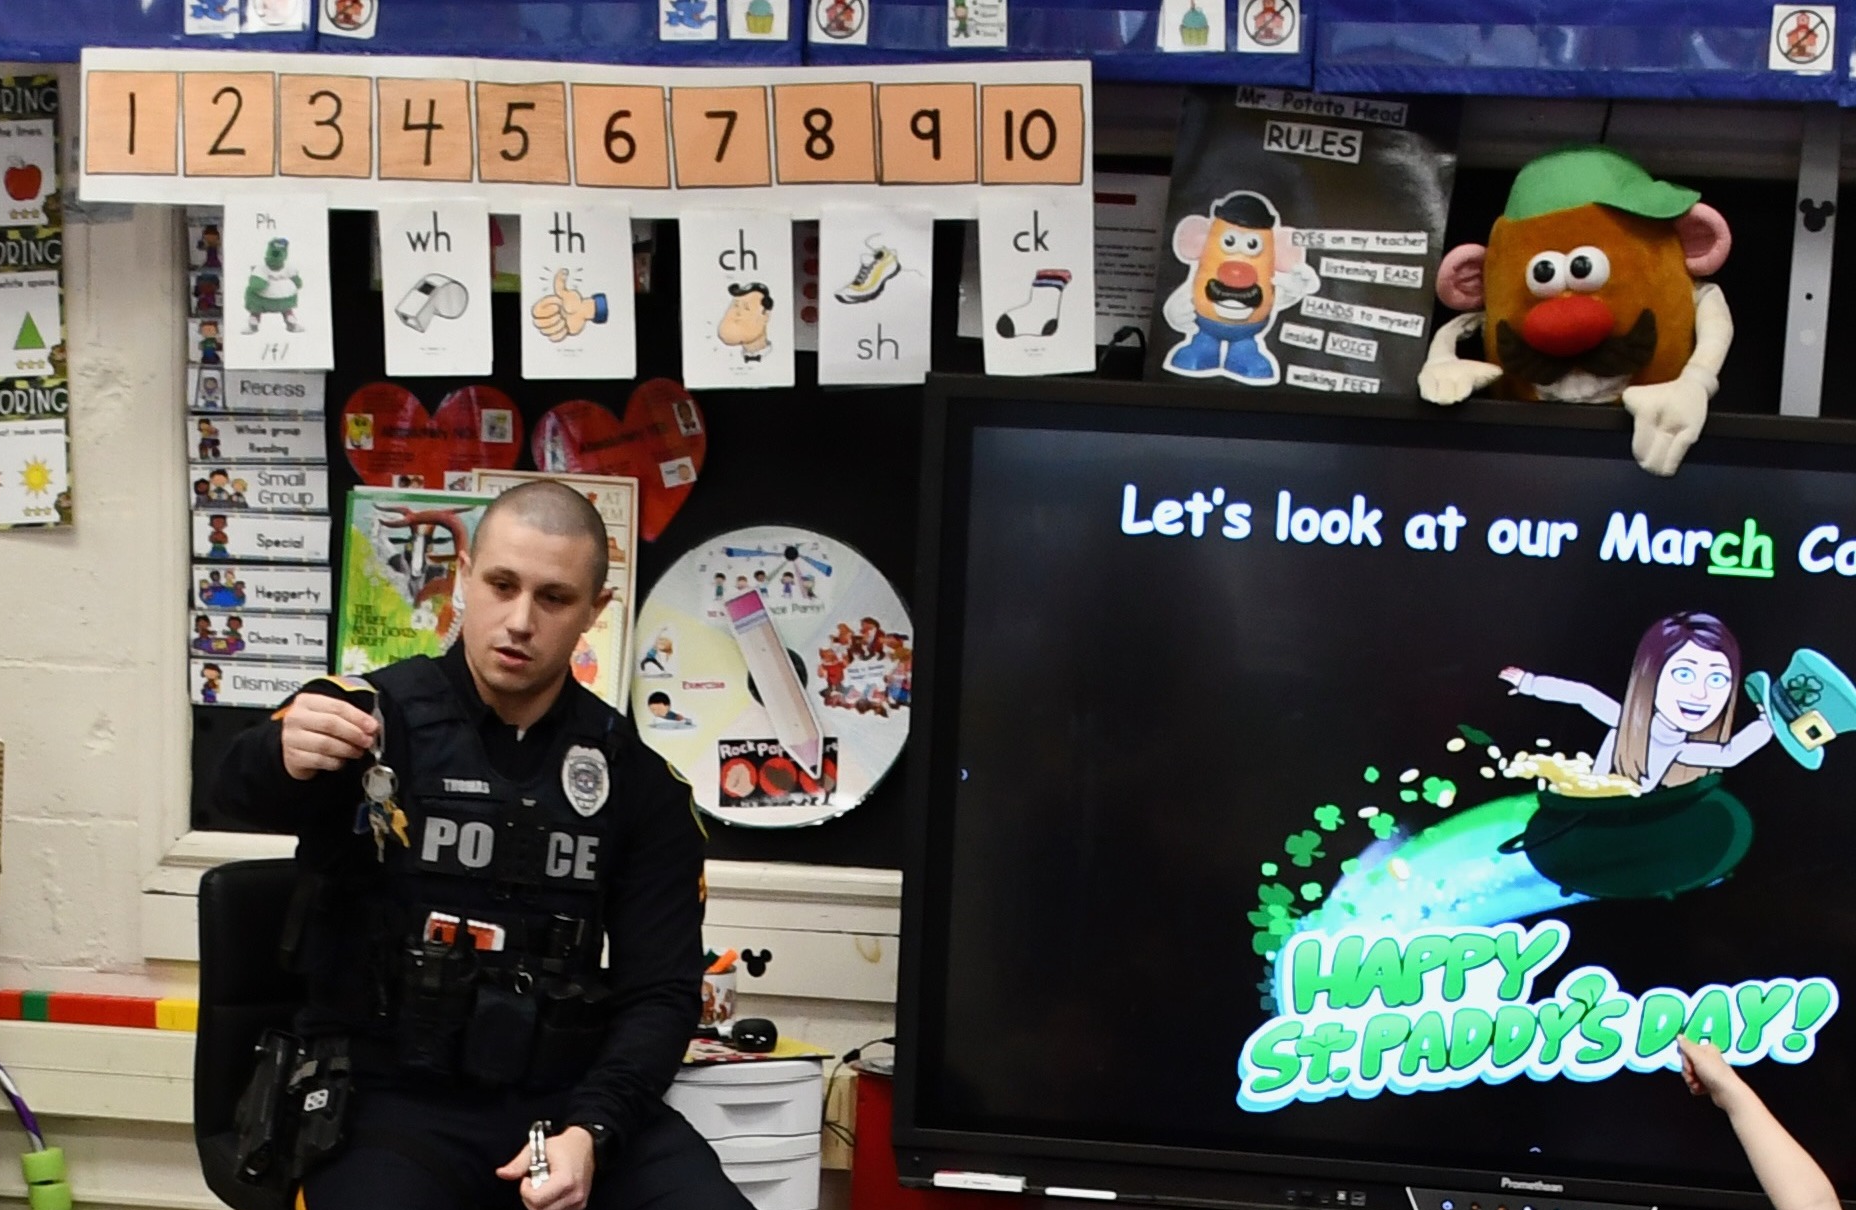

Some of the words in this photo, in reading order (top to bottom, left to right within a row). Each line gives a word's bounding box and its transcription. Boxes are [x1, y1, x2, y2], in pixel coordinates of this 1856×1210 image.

[128, 92, 136, 155] 1
[208, 86, 246, 156] 2
[1282, 93, 1345, 116] Potato
[1352, 102, 1405, 124] Head
[301, 90, 345, 161] 3
[402, 98, 444, 166] 4
[500, 101, 536, 162] 5
[604, 110, 637, 164] 6
[705, 110, 738, 163] 7
[803, 107, 835, 161] 8
[910, 108, 942, 161] 9
[1004, 109, 1058, 161] 10
[1266, 124, 1357, 158] RULES
[256, 213, 277, 230] Ph
[406, 210, 452, 253] wh
[549, 211, 586, 254] th
[1012, 210, 1050, 253] ck
[718, 228, 759, 272] ch
[1292, 232, 1325, 247] EYES
[1331, 236, 1344, 245] on
[1351, 235, 1369, 248] my
[1375, 234, 1426, 247] teacher
[1324, 261, 1377, 282] listening
[1383, 268, 1420, 283] EARS
[1305, 300, 1354, 319] HANDS
[1360, 309, 1373, 321] to
[1378, 312, 1421, 331] myself
[856, 323, 900, 361] sh
[1284, 330, 1319, 345] inside
[1329, 336, 1374, 357] VOICE
[240, 380, 306, 398] Recess
[1292, 374, 1337, 390] walking
[1343, 376, 1377, 393] FEET
[235, 425, 266, 436] Whole
[271, 427, 301, 438] group
[248, 443, 289, 456] Reading
[257, 471, 306, 486] Small
[258, 490, 314, 507] Group
[256, 533, 305, 550] Special
[1121, 484, 1251, 541] Let's
[1276, 491, 1382, 548] look
[1405, 504, 1466, 551] at
[1487, 517, 1578, 559] our
[1600, 512, 1774, 572] March
[255, 585, 321, 603] Heggerty
[247, 631, 289, 645] Choice
[294, 632, 323, 646] Time
[232, 675, 301, 692] Dismiss
[682, 681, 726, 691] Exercise
[719, 740, 755, 759] Rock
[443, 778, 490, 794] THOMAS
[421, 816, 600, 880] POCE
[1293, 929, 1559, 1013] HAPPY
[1501, 1177, 1564, 1194] Promethean
